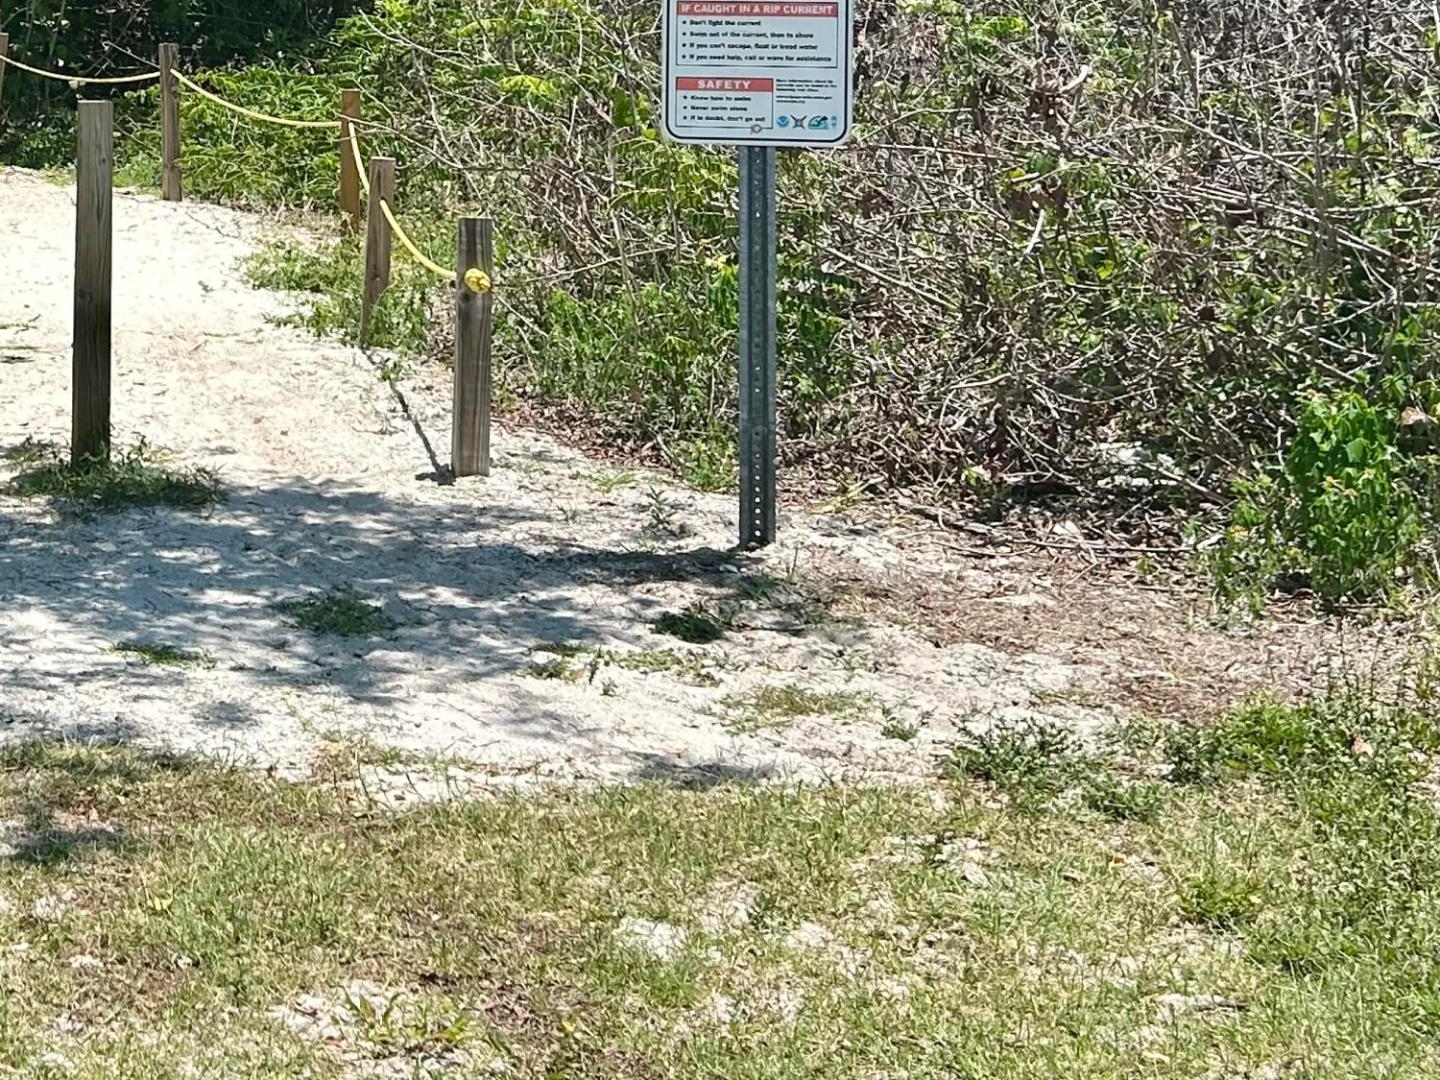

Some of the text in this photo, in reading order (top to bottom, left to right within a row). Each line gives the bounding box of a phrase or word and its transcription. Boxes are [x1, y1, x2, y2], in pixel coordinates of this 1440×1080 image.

[681, 4, 833, 14] IF CAUGHT IN A RIP CURRENT
[697, 80, 751, 89] SAFETY
